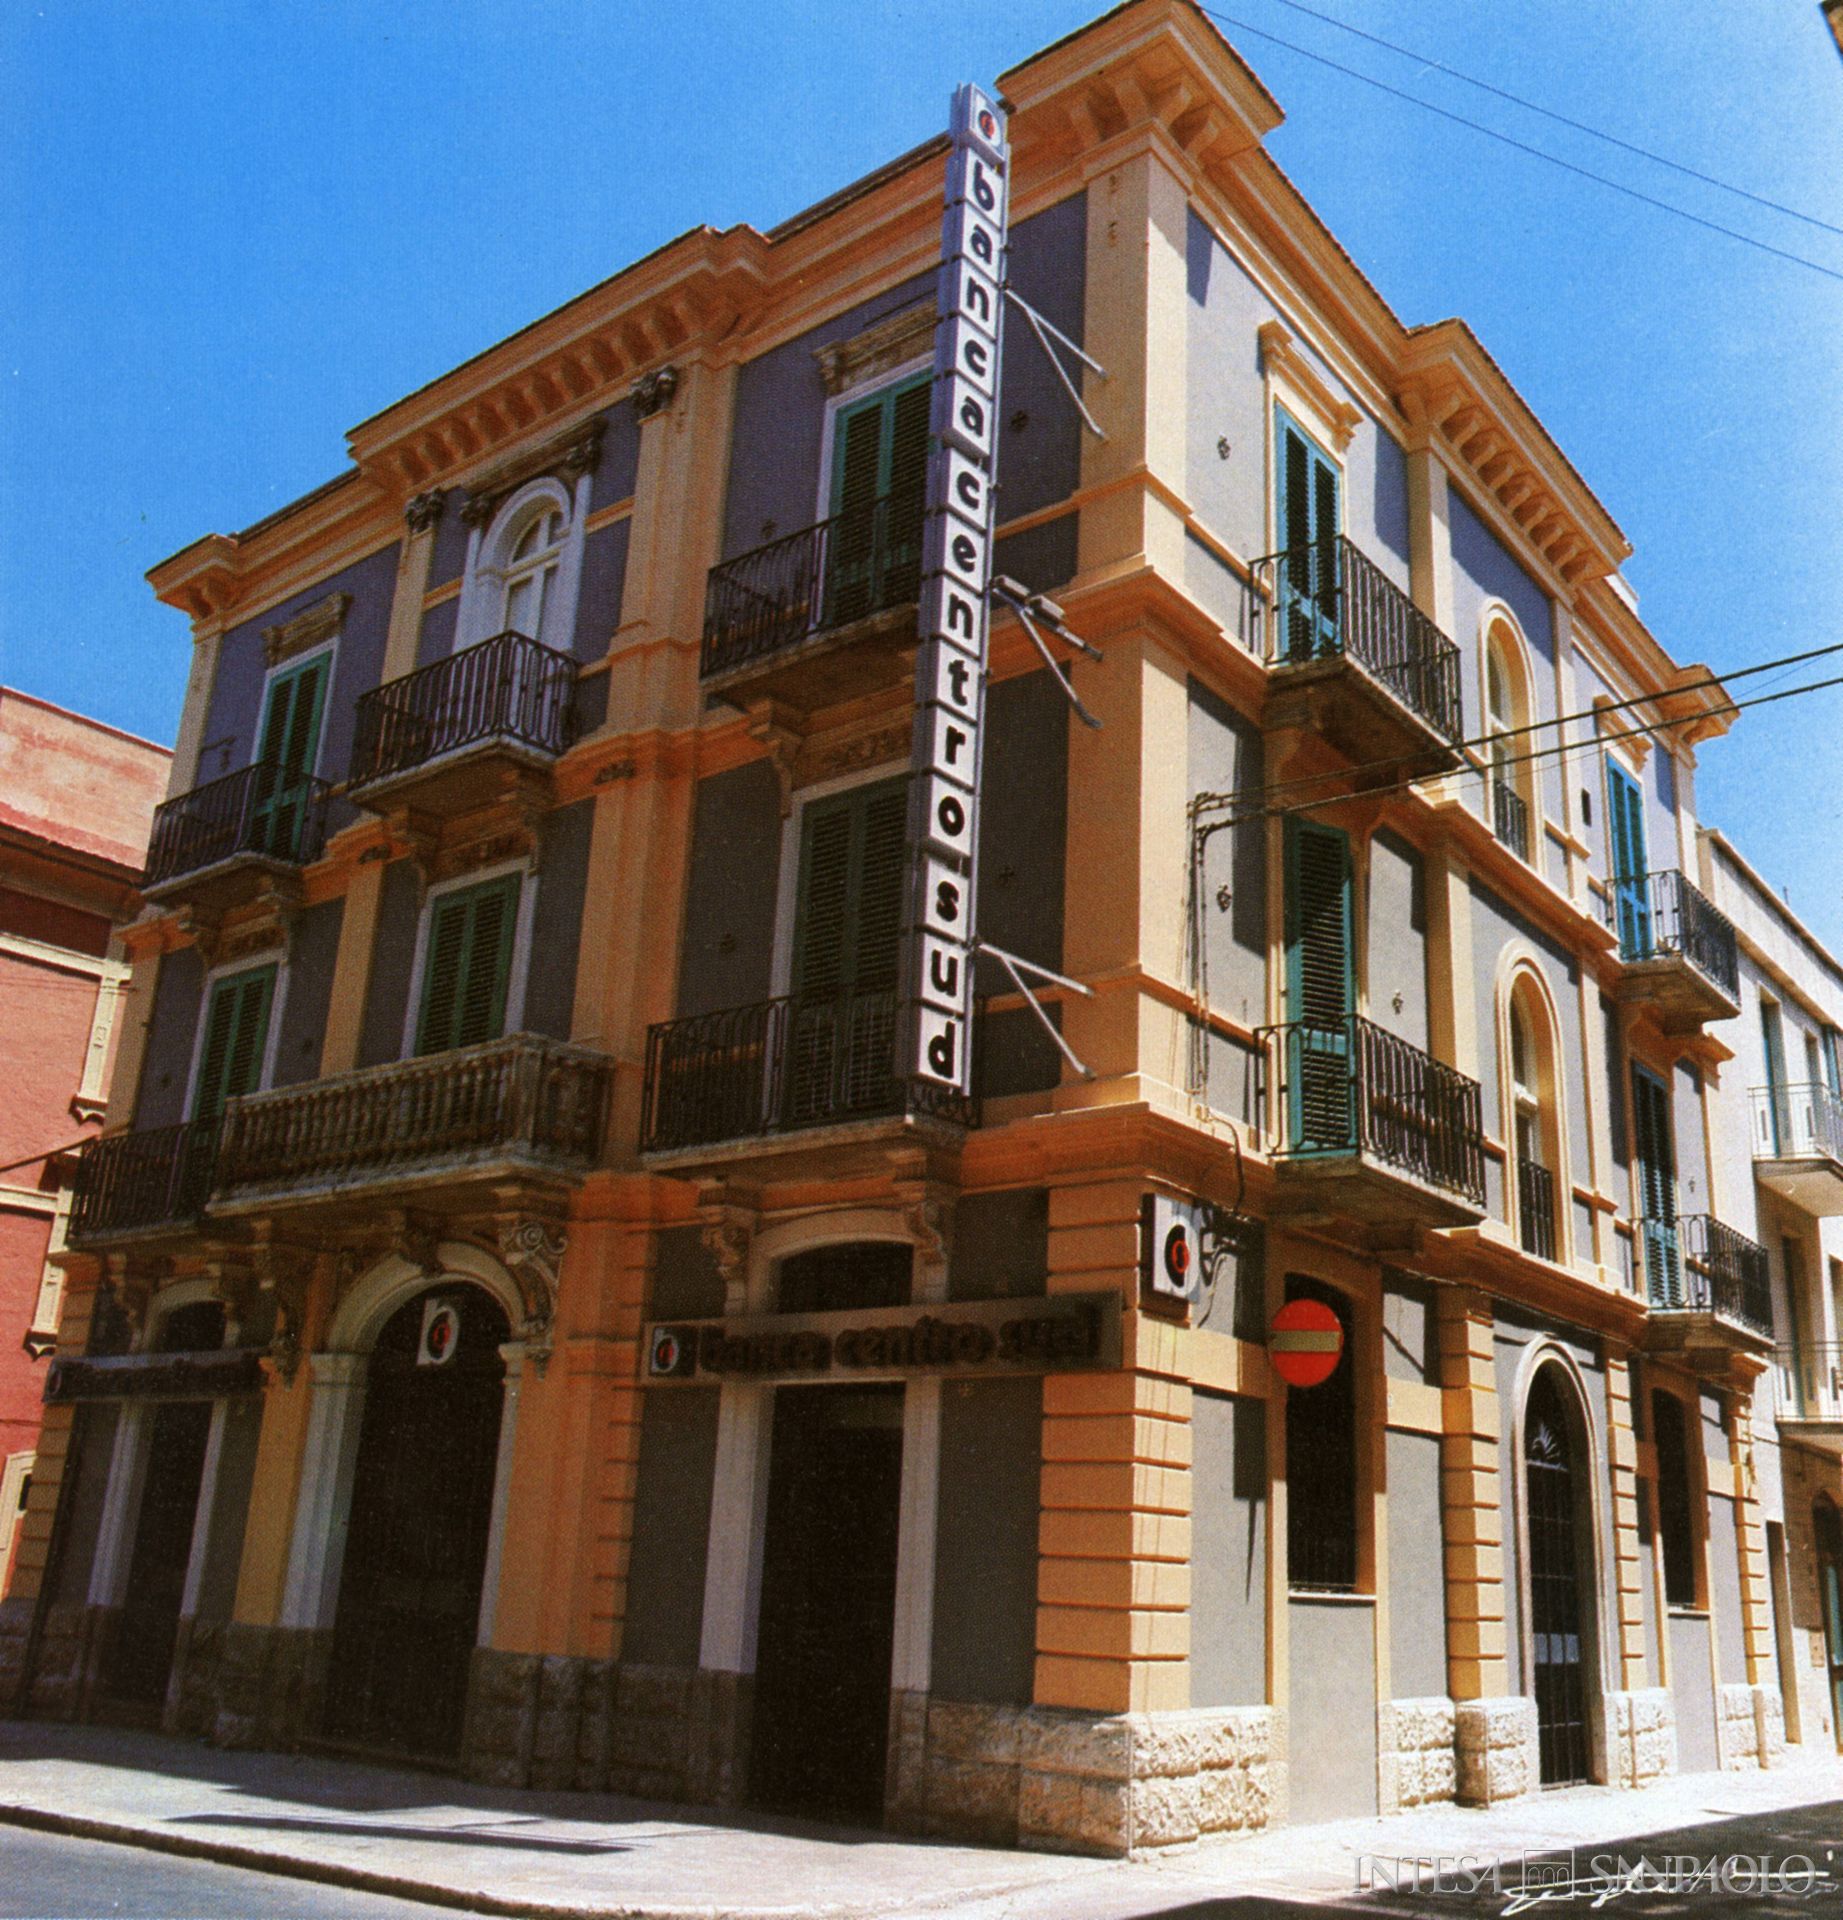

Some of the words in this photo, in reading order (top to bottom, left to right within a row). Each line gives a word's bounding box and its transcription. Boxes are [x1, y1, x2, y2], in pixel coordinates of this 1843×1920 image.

[960, 160, 995, 438] banca
[937, 471, 981, 837] centro
[928, 881, 960, 1078] sud
